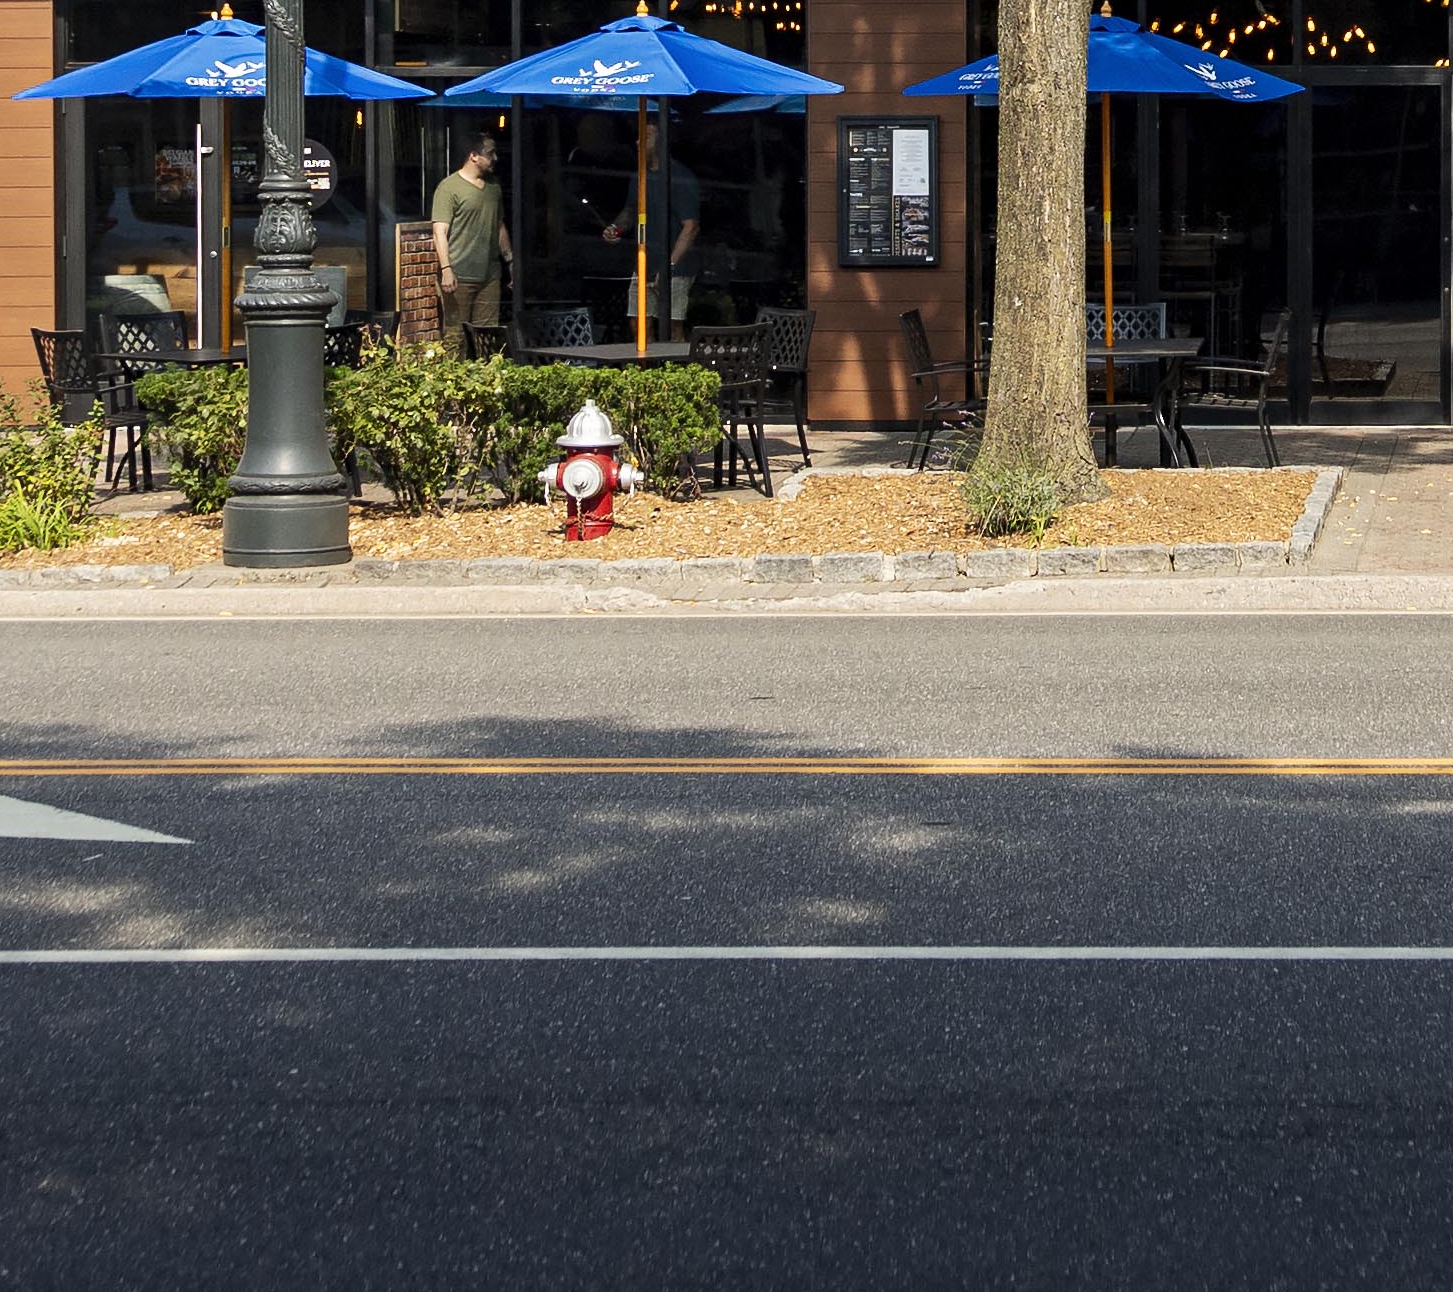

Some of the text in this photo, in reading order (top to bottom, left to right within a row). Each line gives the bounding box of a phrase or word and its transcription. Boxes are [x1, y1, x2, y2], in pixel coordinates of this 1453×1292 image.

[186, 77, 266, 87] GREY GOO
[551, 75, 649, 85] GREY GOOSE
